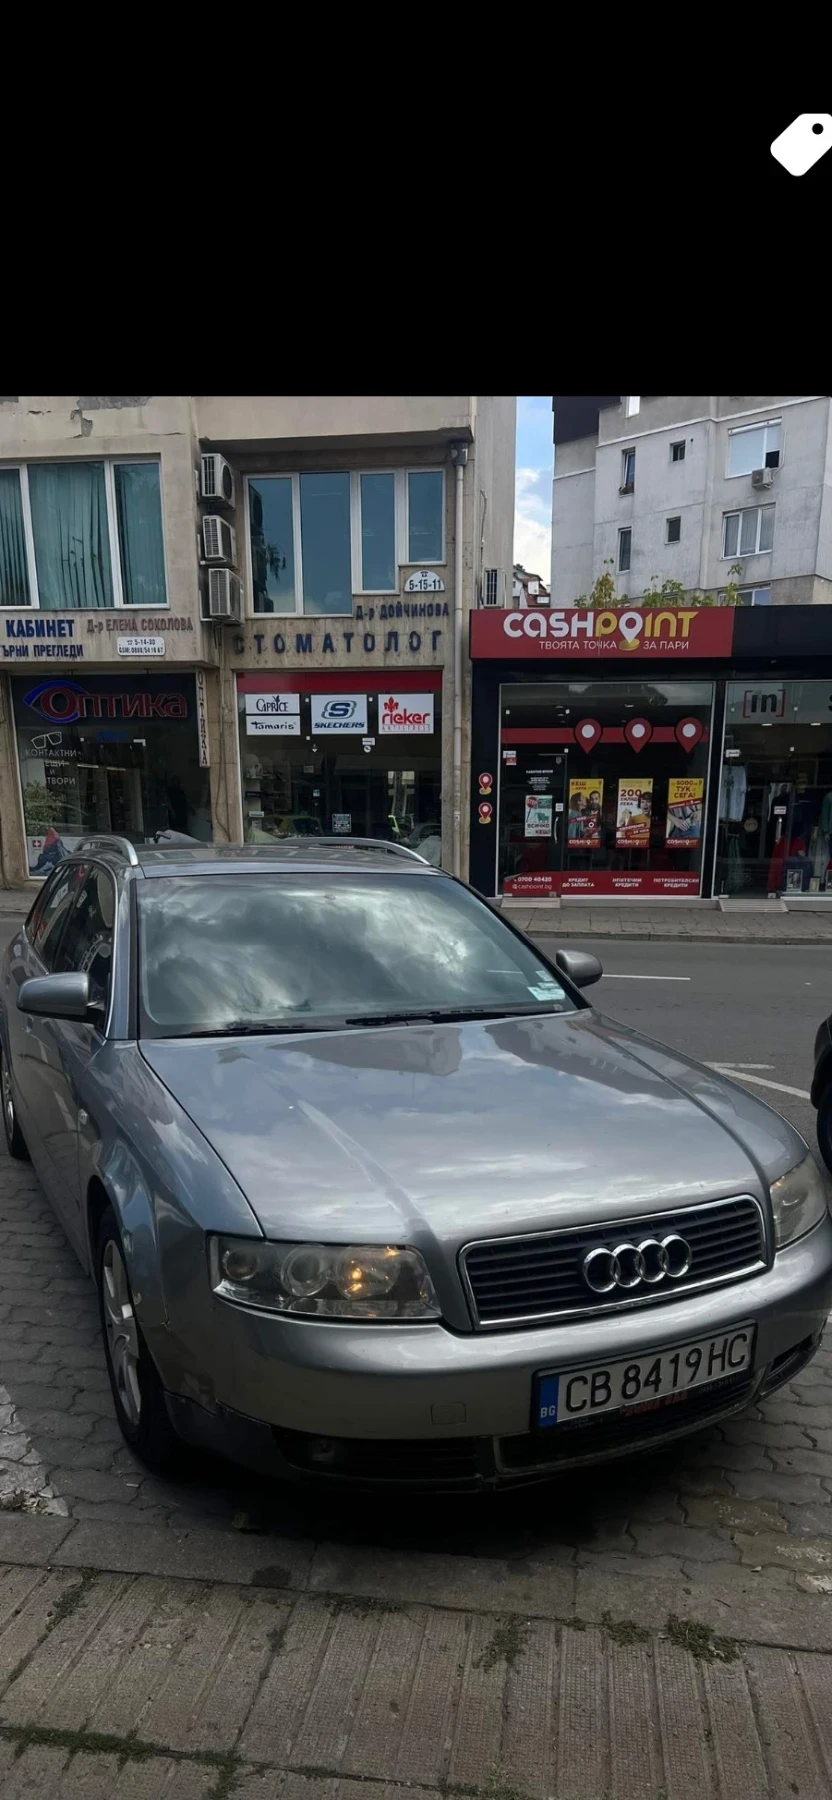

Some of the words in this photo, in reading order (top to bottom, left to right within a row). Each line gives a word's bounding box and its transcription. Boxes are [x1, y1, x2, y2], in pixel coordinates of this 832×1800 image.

[409, 580, 441, 590] 5-15-11
[380, 602, 450, 620] ДОЙЧИНОВА
[6, 619, 75, 638] КАБИНЕТ
[106, 618, 138, 632] ЕЛЕНА
[140, 616, 194, 632] СОКОЛОВА
[233, 630, 442, 654] СТОМАТОЛОГ
[539, 641, 580, 650] ТВОЯТА
[584, 641, 617, 650] ТОЧКА
[643, 641, 657, 650] ЗА
[660, 641, 689, 650] ПАРИ
[0, 644, 29, 658] ЪРНИ
[33, 644, 84, 659] ПРЕГЛЕДИ
[382, 708, 430, 725] rieker
[251, 722, 294, 730] Tamaris
[26, 749, 77, 757] КОНТАКТНИ
[620, 789, 642, 797] 200
[566, 1370, 612, 1413] CB
[621, 1348, 702, 1400] 8419
[708, 1333, 748, 1377] HC
[540, 1405, 556, 1419] BG
